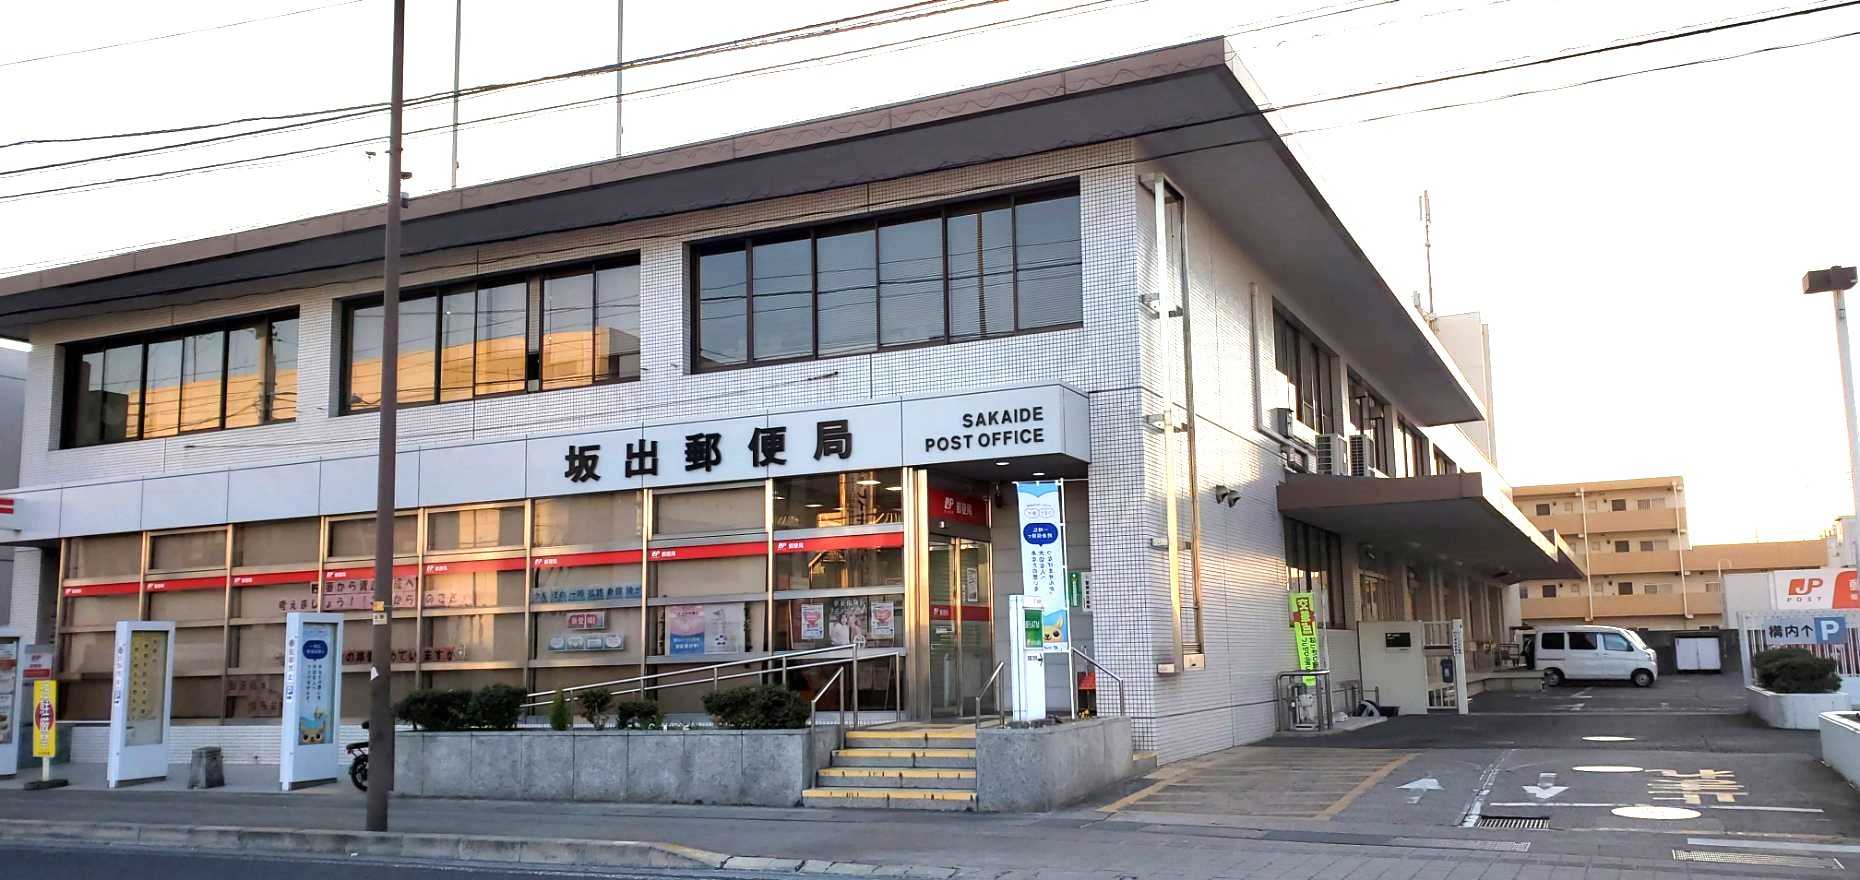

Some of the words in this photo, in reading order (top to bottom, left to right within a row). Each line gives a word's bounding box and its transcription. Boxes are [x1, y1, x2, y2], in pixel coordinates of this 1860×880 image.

[962, 406, 1044, 428] SAKAIDE
[564, 419, 852, 484] 坂出郵便局
[925, 433, 973, 452] POST
[977, 428, 1045, 449] OFFICE
[1768, 624, 1799, 638] 構内
[1820, 620, 1840, 641] P
